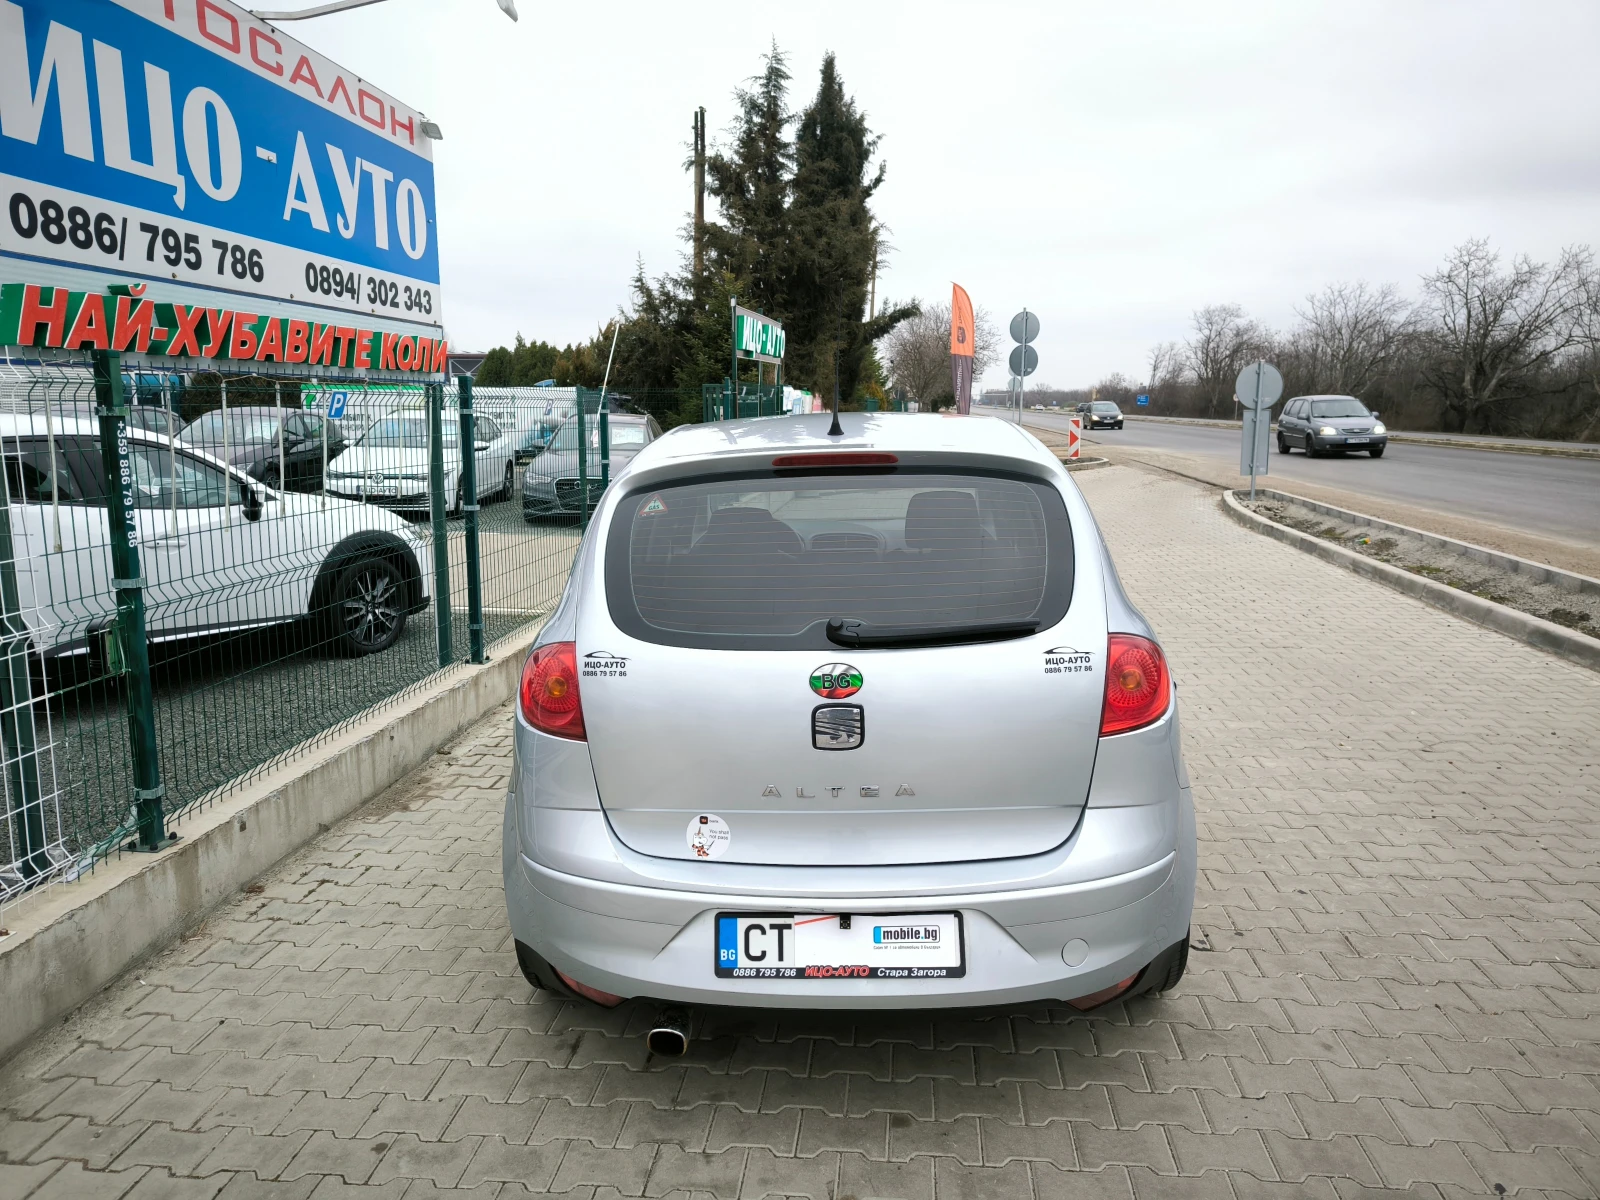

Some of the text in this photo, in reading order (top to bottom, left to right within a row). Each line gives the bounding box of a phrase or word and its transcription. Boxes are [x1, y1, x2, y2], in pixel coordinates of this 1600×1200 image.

[9, 192, 265, 283] 0886/ 795 786
[367, 276, 400, 308] 302
[404, 285, 432, 315] 343
[17, 283, 449, 374] НАЙ-ХУБАВИТЕ КОЛИ
[743, 315, 786, 359] ИЦО-АУТО
[117, 420, 138, 547] +359 886 79 57 86
[584, 661, 626, 669] ИЦО-АУТО
[1045, 656, 1091, 666] ИЦО-АУТО
[1044, 666, 1062, 674] 0886
[821, 672, 851, 690] BG
[761, 784, 916, 798] ALTEA
[882, 927, 938, 942] mobile.bg
[720, 949, 736, 961] BG
[733, 968, 797, 978] 0886 795 786
[805, 965, 870, 978] ИЦО-АУТО
[877, 967, 947, 979] Стара Загора
